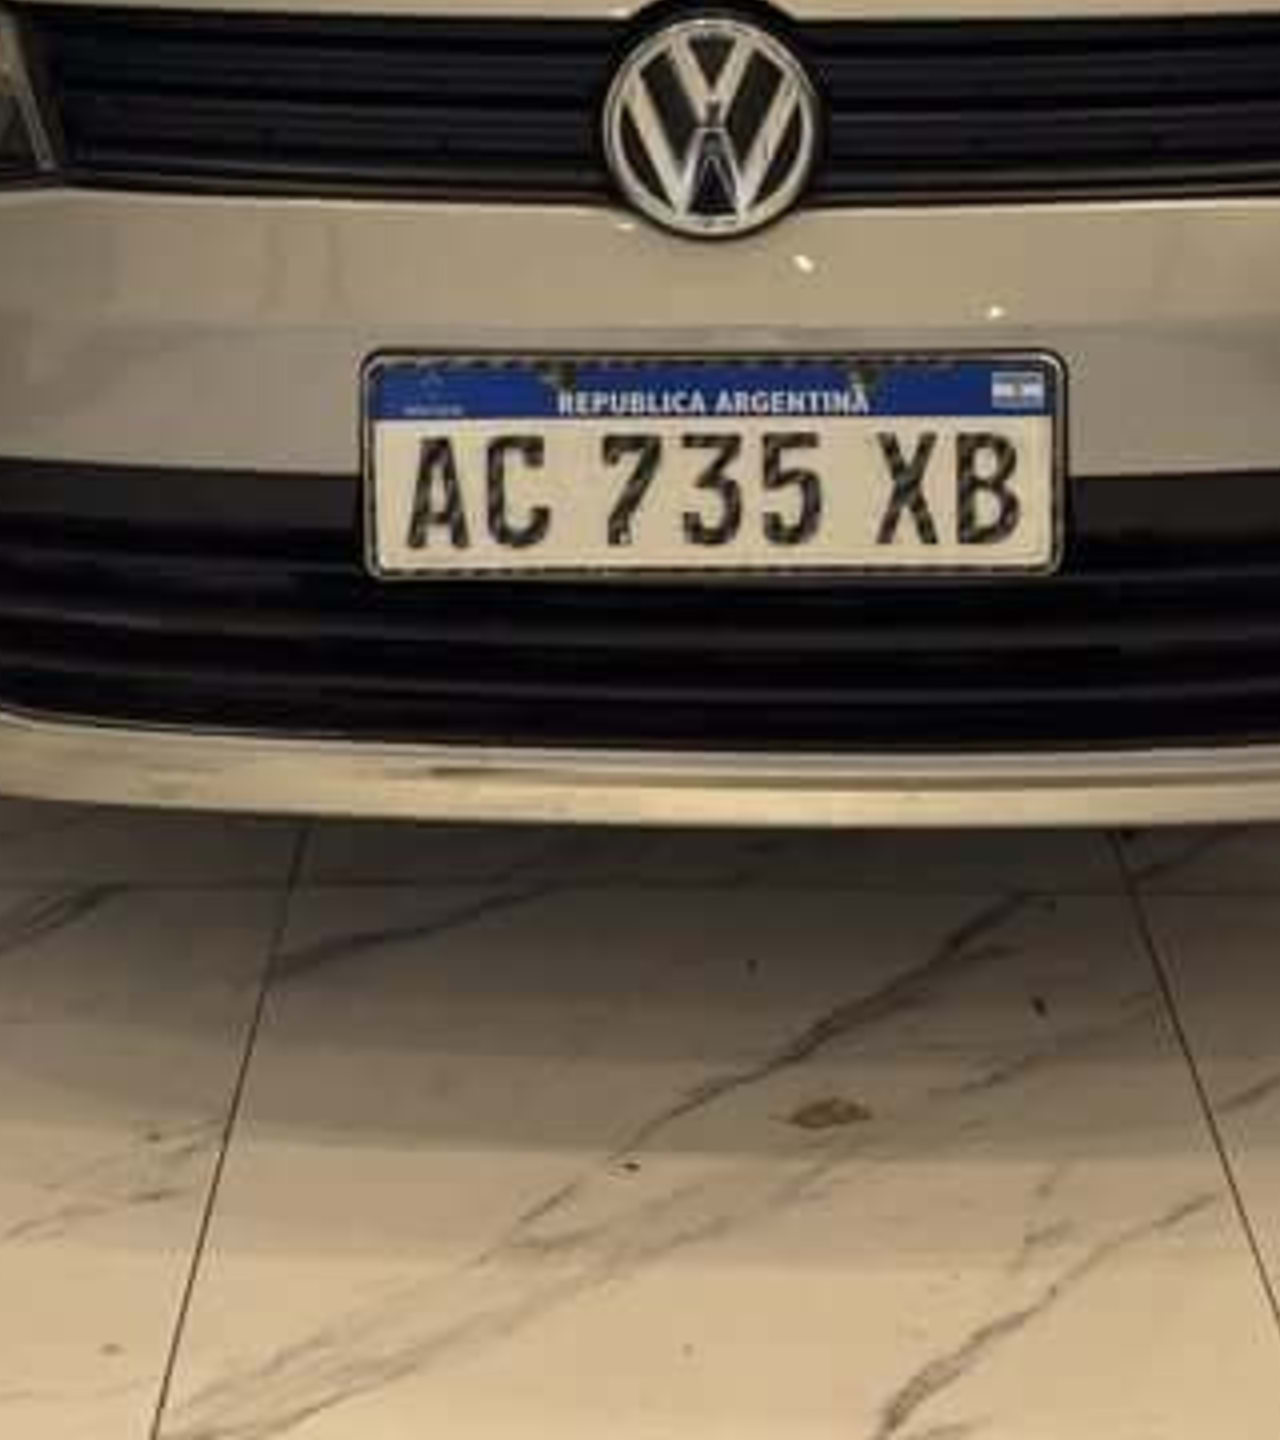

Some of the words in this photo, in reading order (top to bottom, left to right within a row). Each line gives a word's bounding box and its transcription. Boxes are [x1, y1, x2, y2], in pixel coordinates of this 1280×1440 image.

[714, 389, 869, 416] ARGENTINA
[405, 434, 553, 550] AC
[600, 431, 821, 548] 735
[875, 430, 1021, 547] XB
